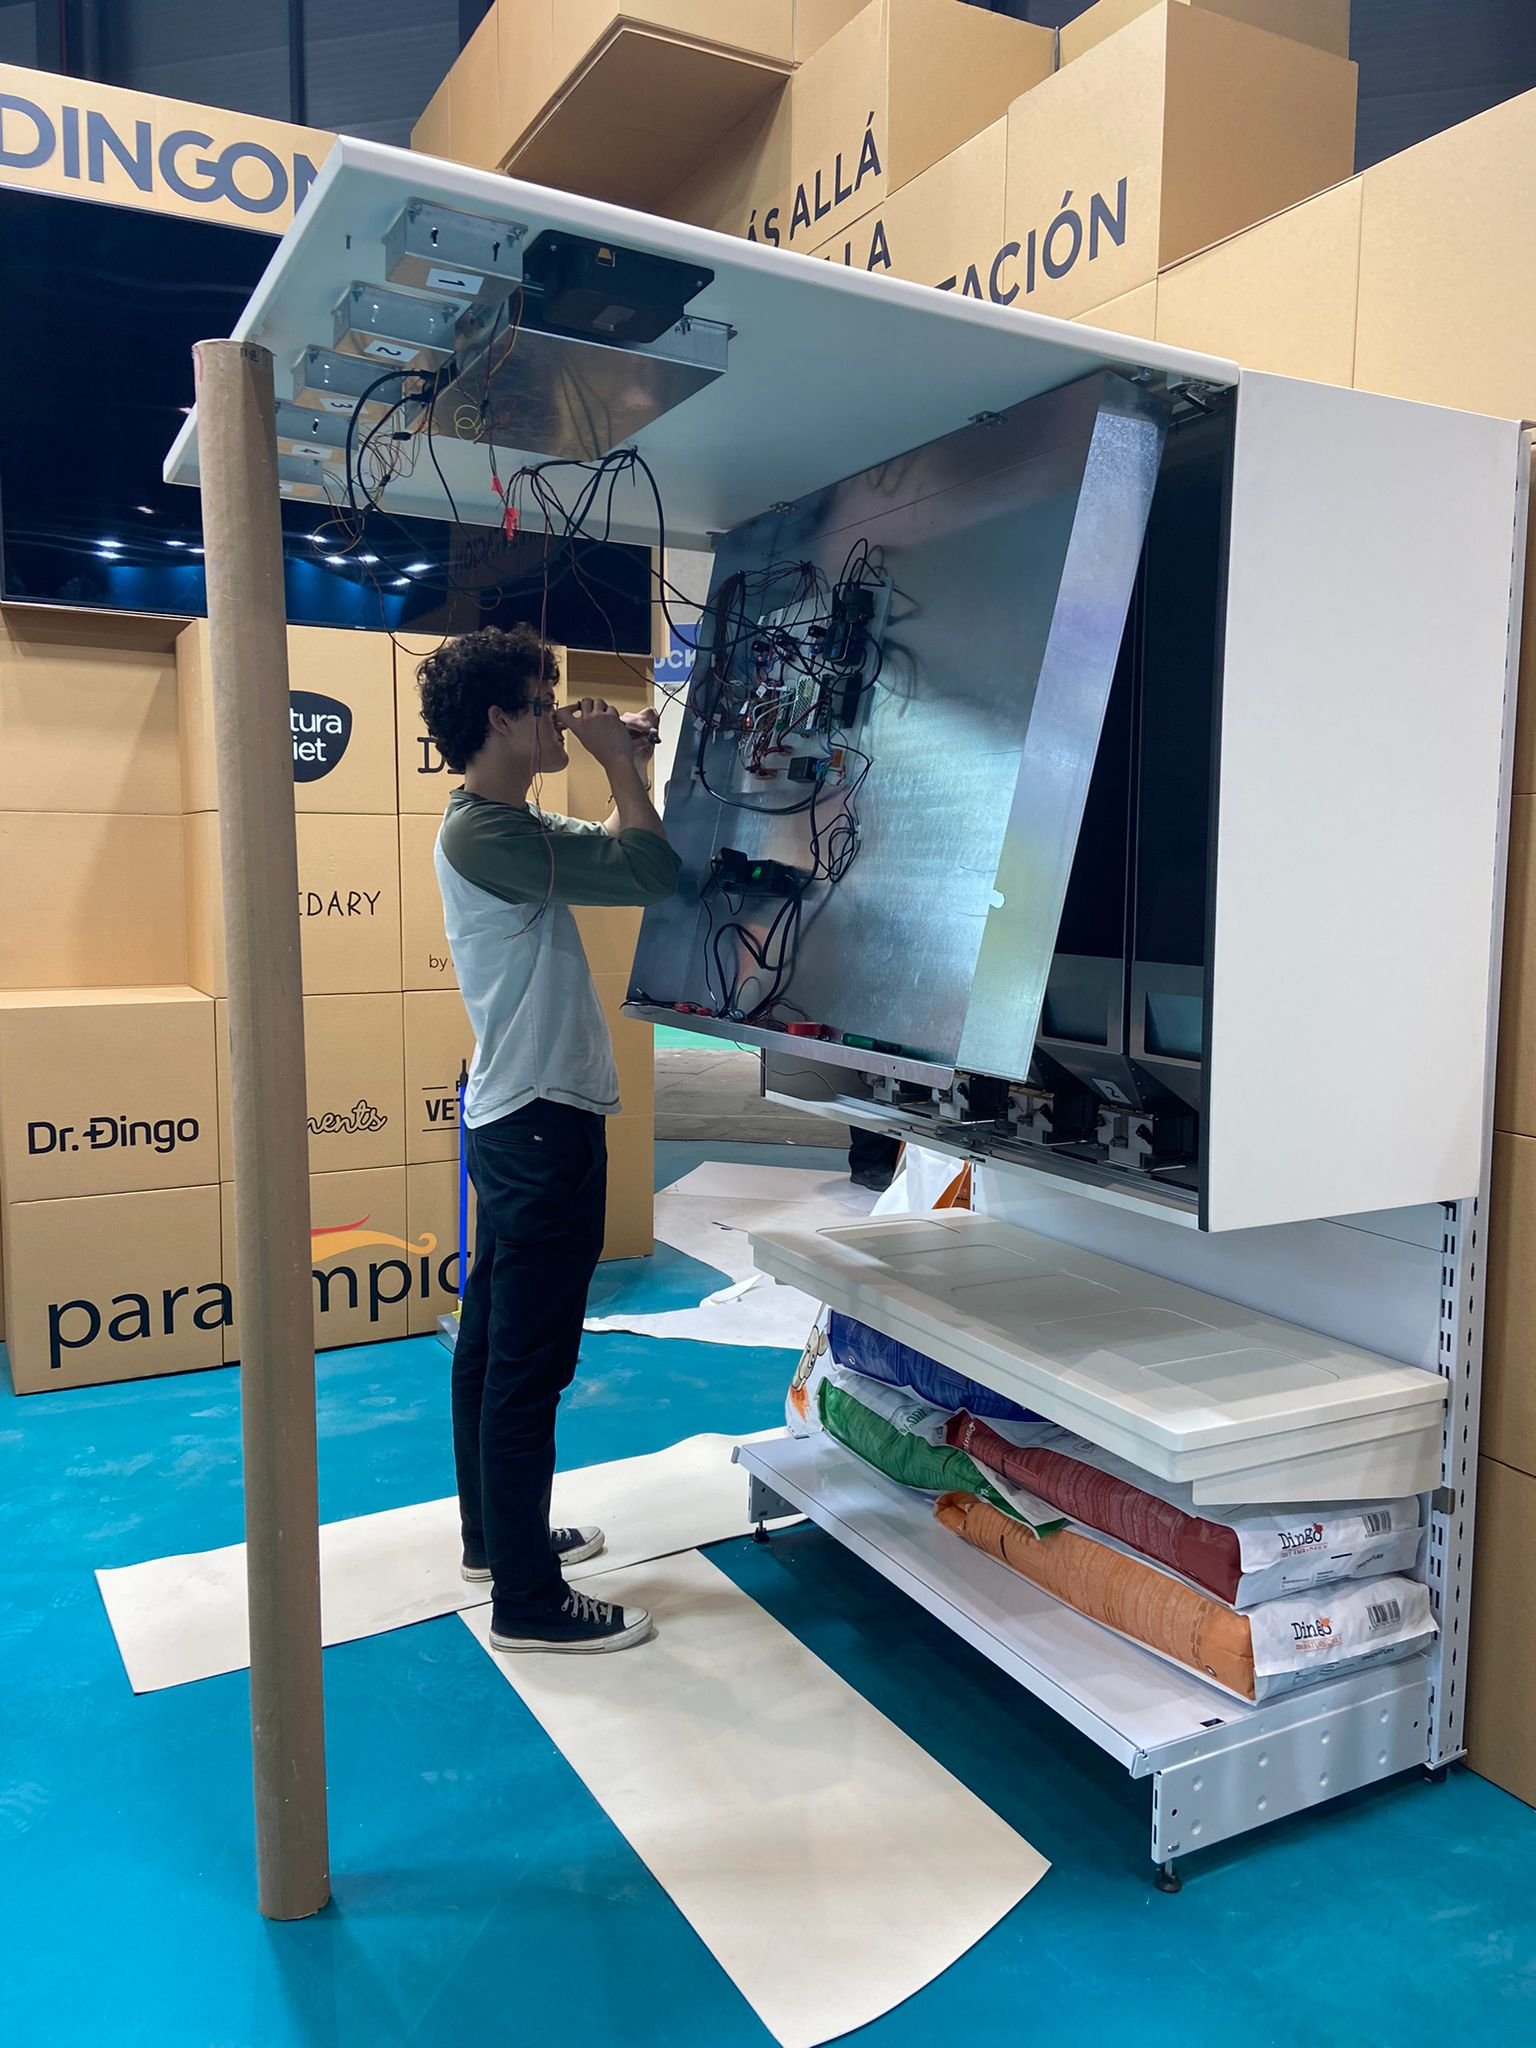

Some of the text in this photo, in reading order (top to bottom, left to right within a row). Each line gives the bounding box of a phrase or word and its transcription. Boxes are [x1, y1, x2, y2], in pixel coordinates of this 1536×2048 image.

[789, 111, 882, 241] ALLÁ
[298, 890, 381, 917] DARY
[429, 953, 448, 972] by
[1278, 1525, 1323, 1549] Dingo
